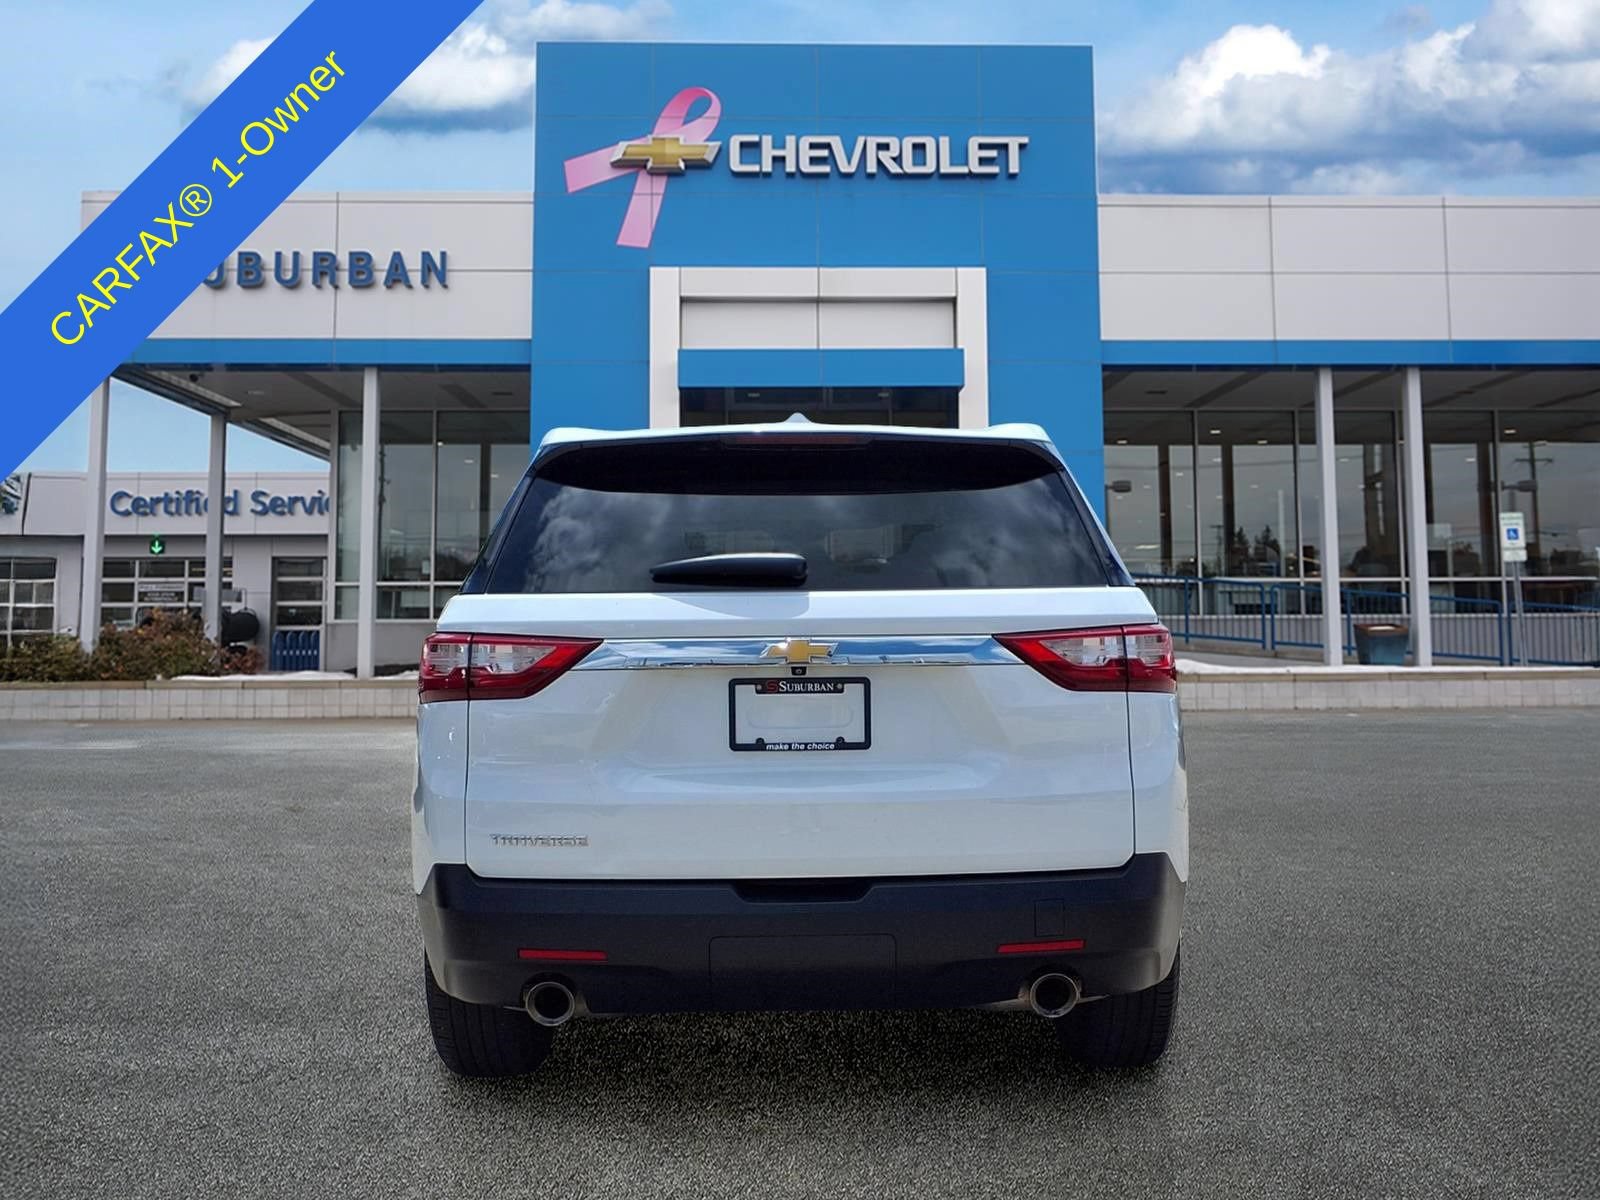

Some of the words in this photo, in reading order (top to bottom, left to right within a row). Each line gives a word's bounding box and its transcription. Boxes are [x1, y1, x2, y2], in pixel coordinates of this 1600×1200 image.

[729, 135, 1029, 174] CHEVROLET
[203, 251, 448, 288] UBURBAN
[110, 490, 239, 516] Certifid
[779, 681, 834, 692] SUBURBAN
